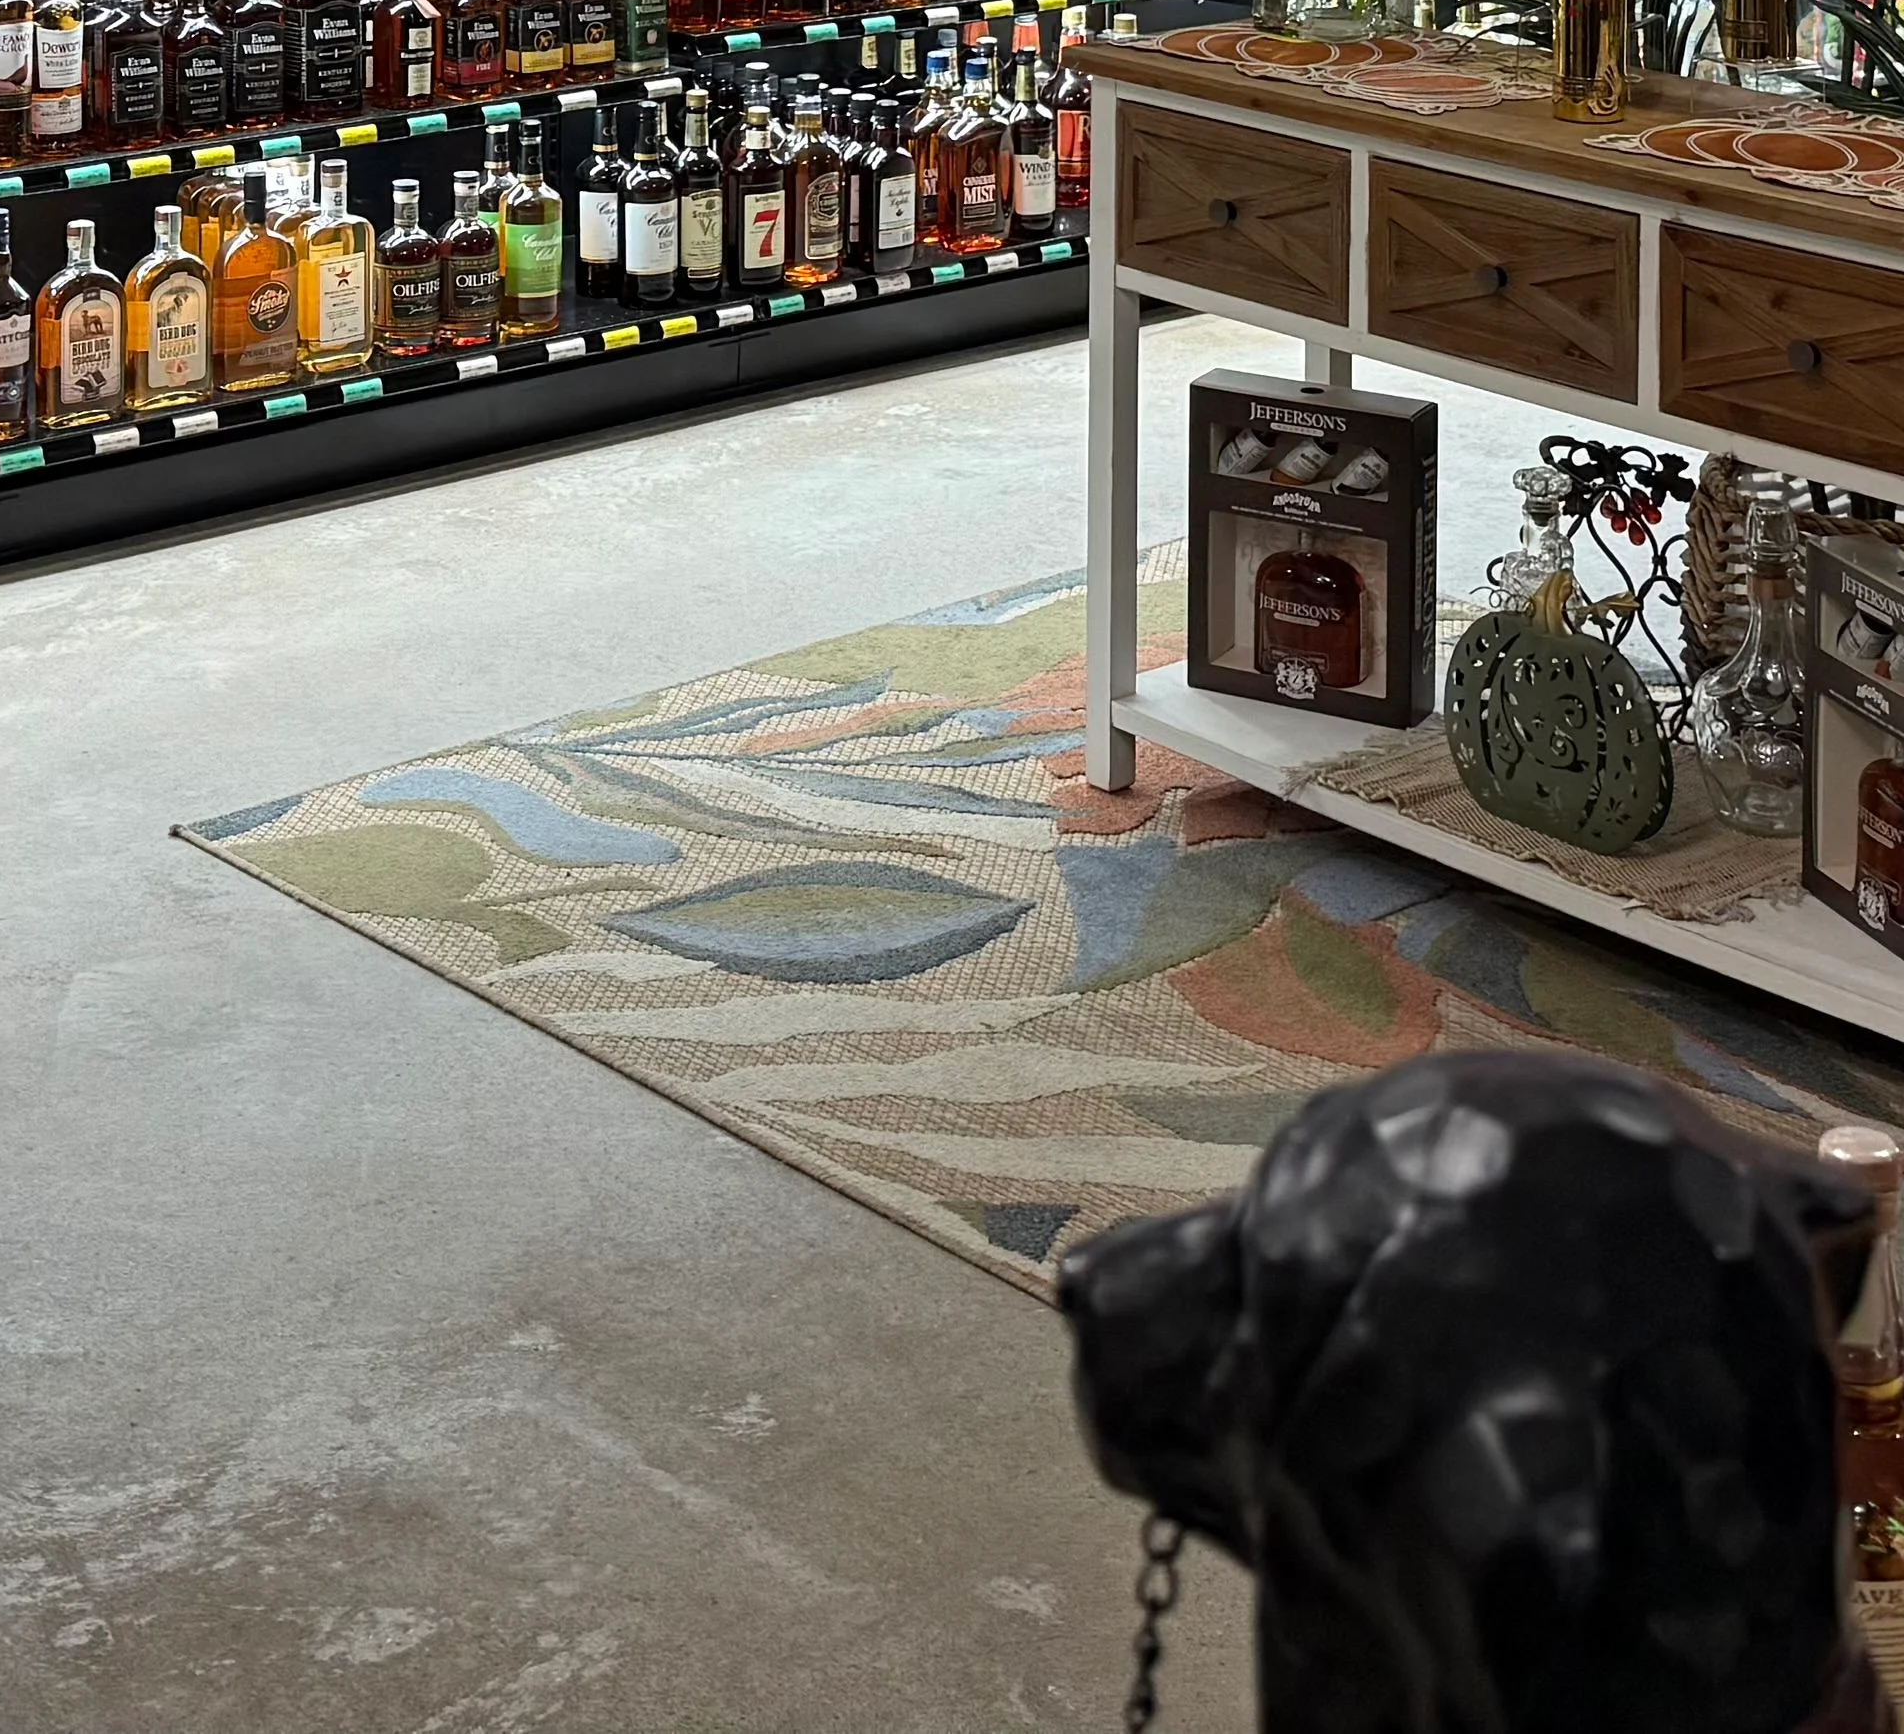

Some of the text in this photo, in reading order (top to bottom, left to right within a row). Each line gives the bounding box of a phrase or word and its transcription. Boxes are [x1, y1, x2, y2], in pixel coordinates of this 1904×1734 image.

[584, 4, 604, 14] Evan
[533, 12, 553, 22] Evan
[578, 11, 611, 22] Williams
[322, 18, 348, 30] Evan
[474, 22, 494, 31] Evan
[528, 20, 560, 30] Williams
[252, 34, 275, 44] Evan
[313, 27, 357, 41] Williams
[468, 30, 499, 41] Williams
[243, 43, 284, 55] Williams
[127, 58, 150, 68] Evan
[192, 58, 215, 68] Evan
[119, 65, 158, 78] Williams
[185, 66, 224, 78] Williams
[965, 187, 995, 205] MIST
[751, 209, 781, 258] 7
[392, 279, 441, 298] OILFIRE
[1249, 402, 1346, 432] JEFFERSON'S
[1259, 593, 1341, 621] JEFFERSON'S
